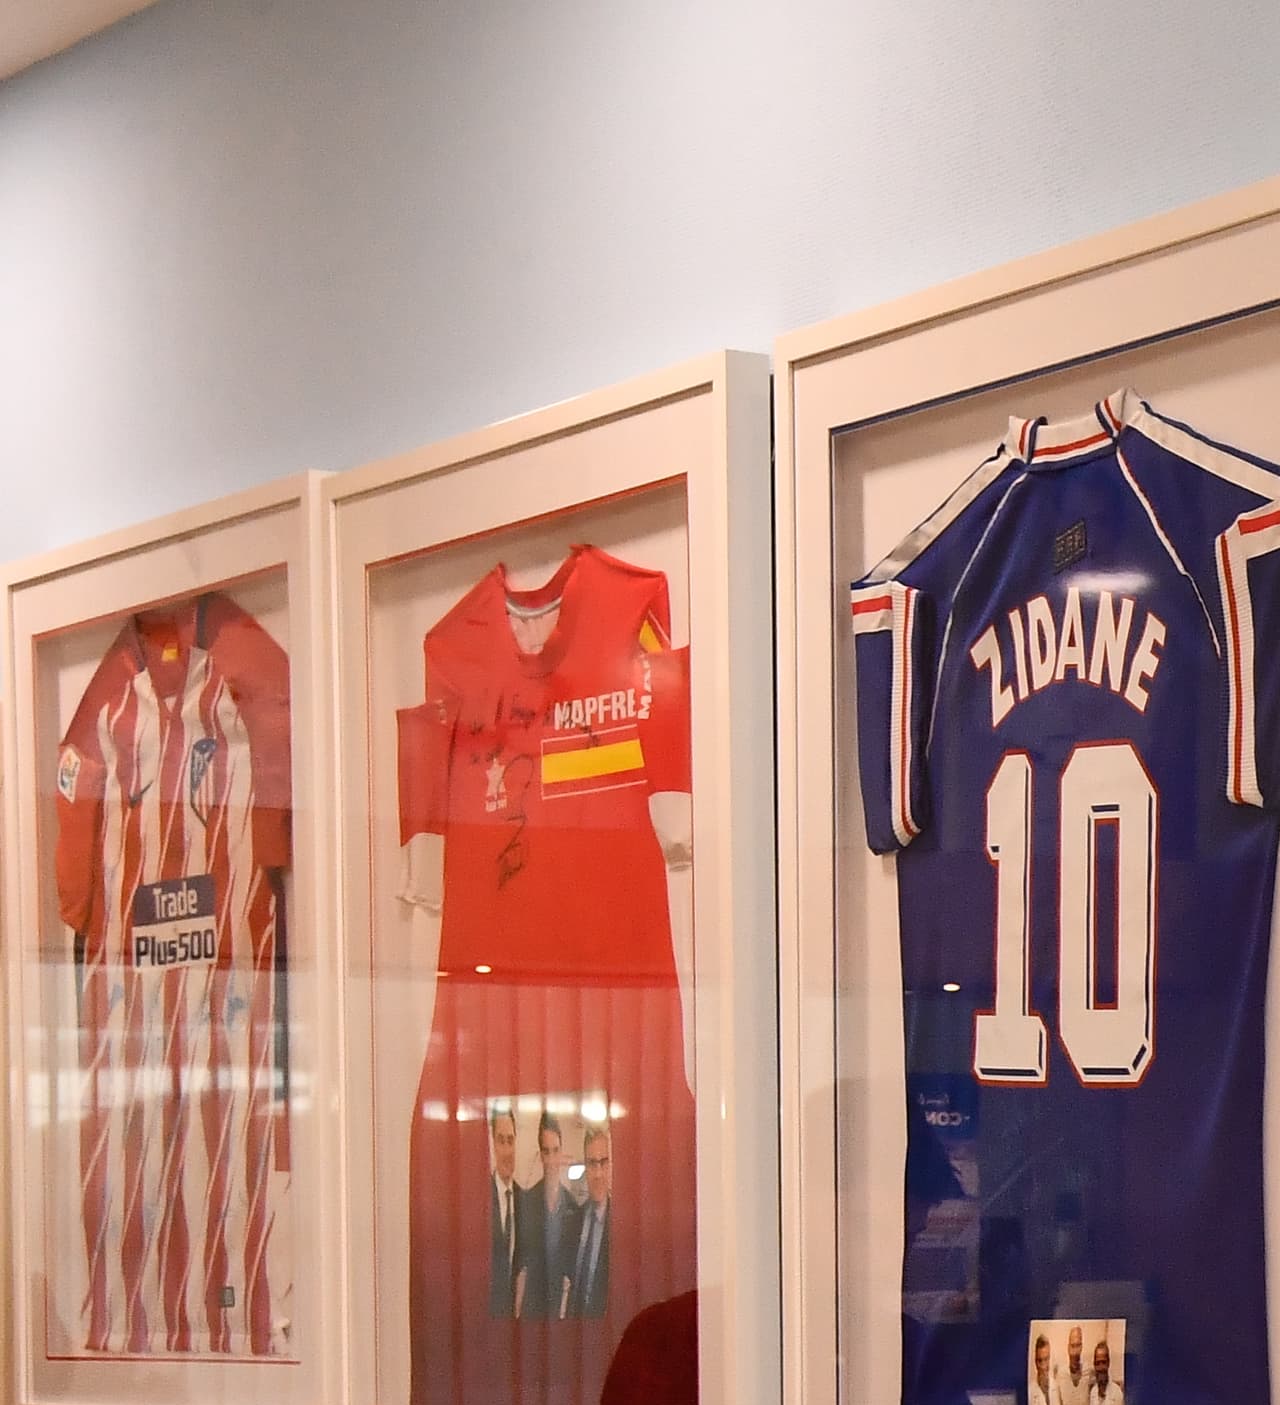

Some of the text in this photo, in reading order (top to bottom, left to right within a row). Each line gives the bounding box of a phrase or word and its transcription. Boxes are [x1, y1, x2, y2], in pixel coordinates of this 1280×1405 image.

[969, 586, 1167, 729] ZIDANE
[554, 688, 637, 731] MAPFRE
[152, 881, 199, 919] Trade
[972, 738, 1161, 1089] 10
[135, 929, 216, 968] Plus500
